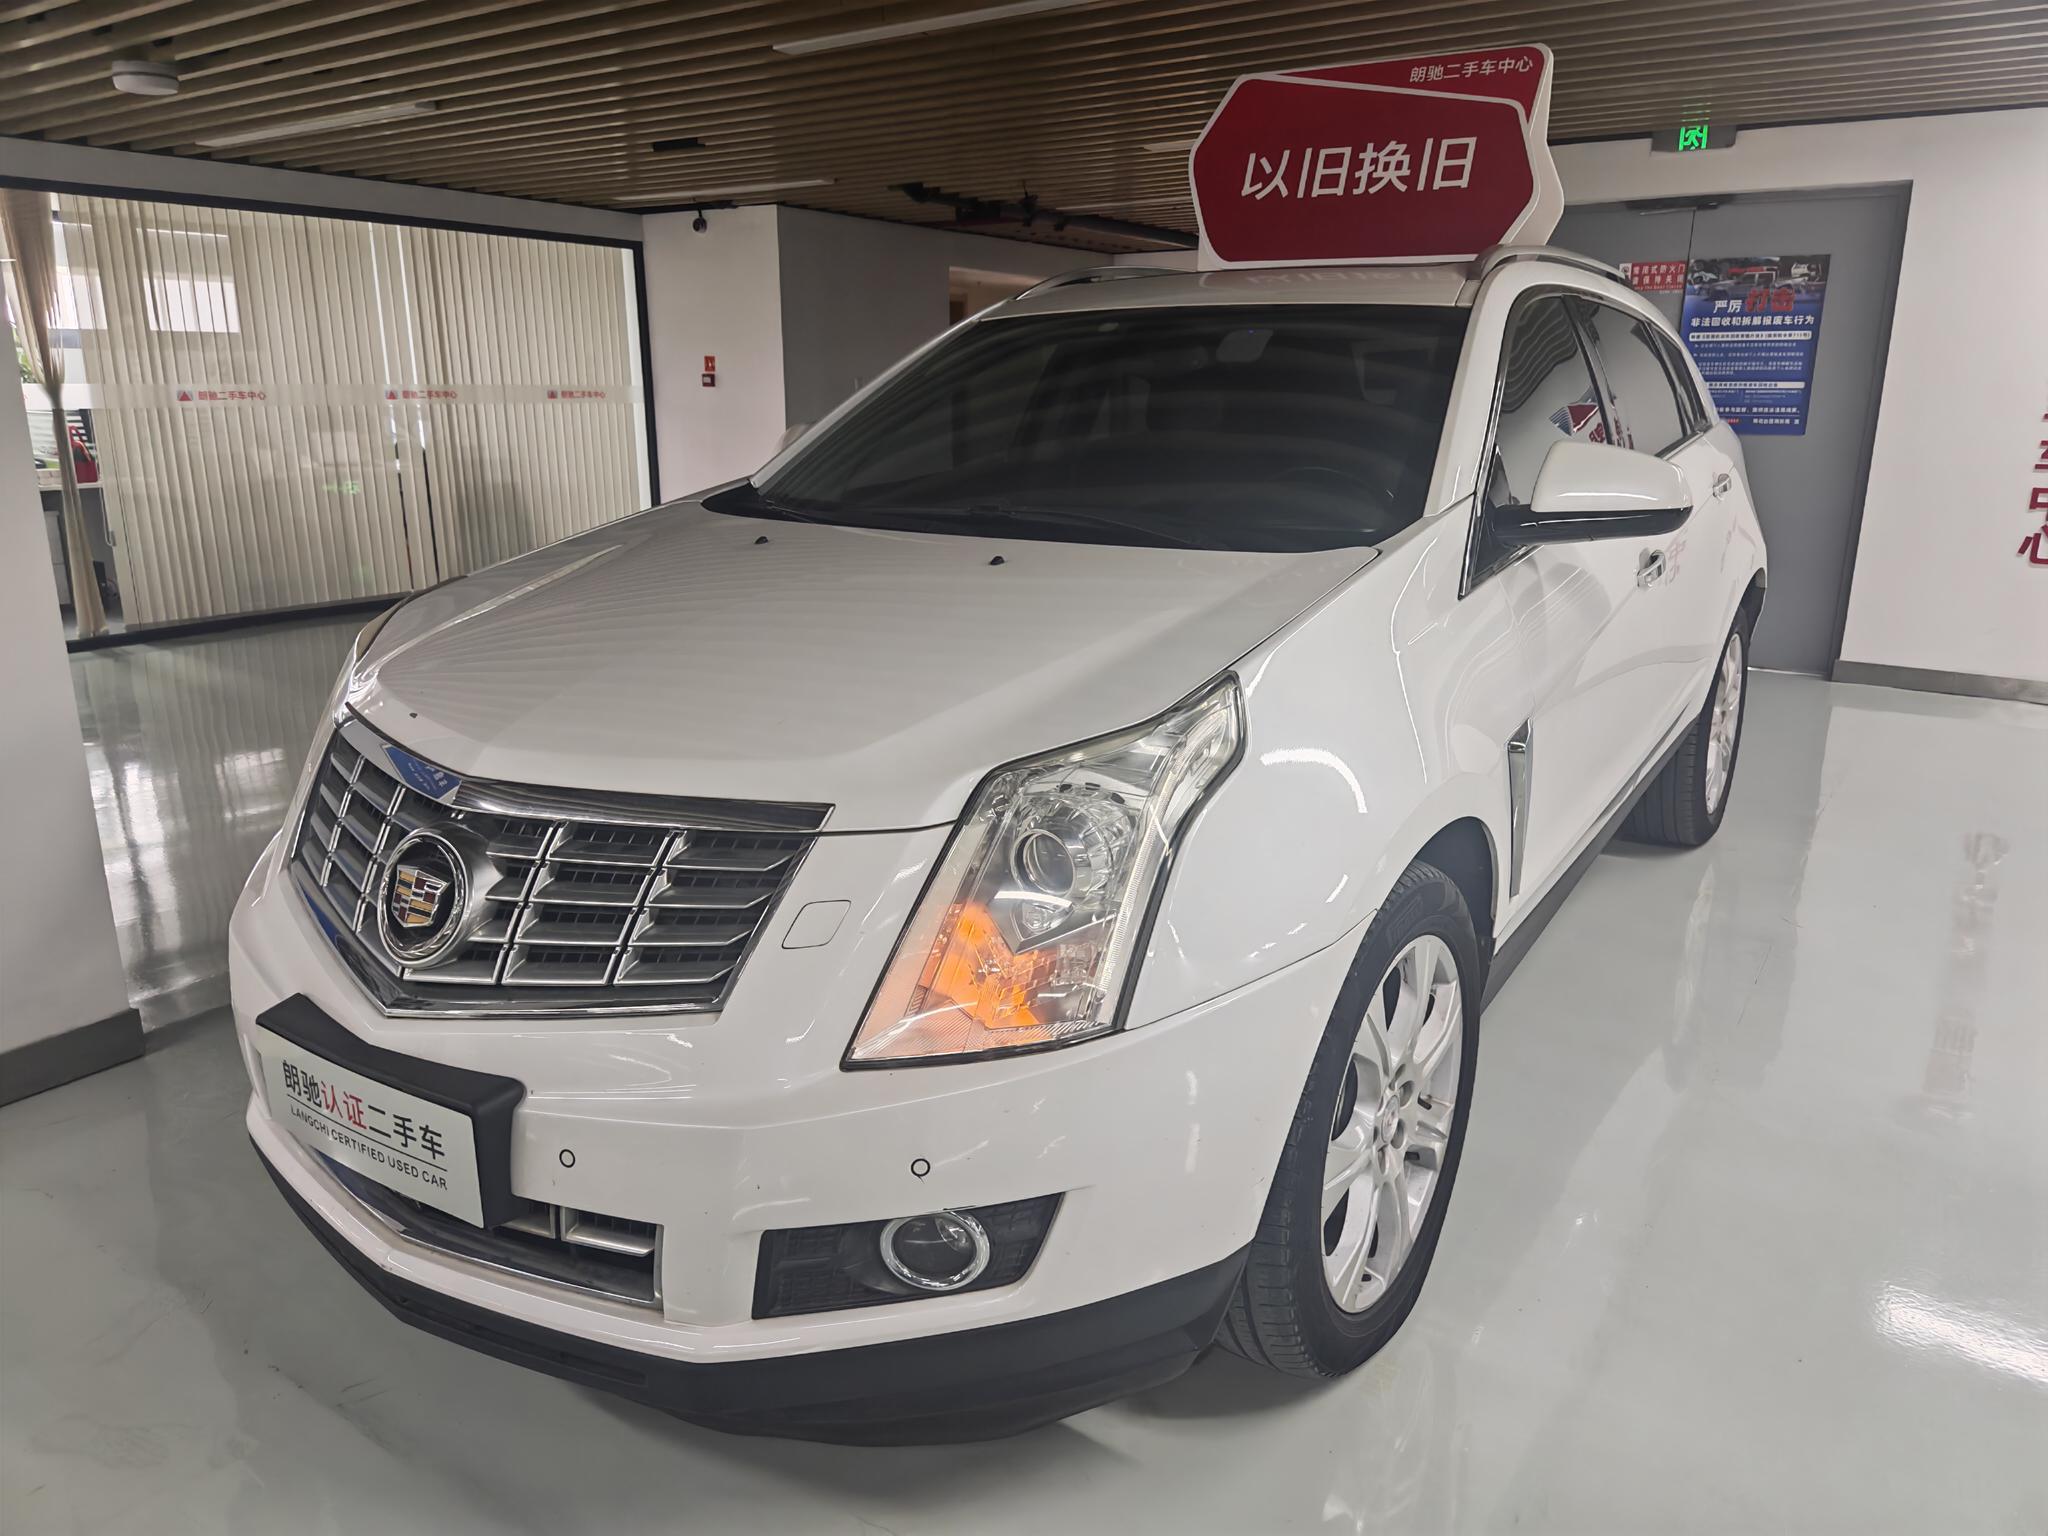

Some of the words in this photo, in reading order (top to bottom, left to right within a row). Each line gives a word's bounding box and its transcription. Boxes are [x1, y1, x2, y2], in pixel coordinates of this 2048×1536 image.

[1409, 56, 1533, 83] 朗驰二手车中心
[1241, 136, 1477, 200] 以旧换旧
[282, 1059, 446, 1160] 朗驰认证二手车
[290, 1104, 330, 1136] LANGCHI
[331, 1129, 385, 1163] CERTIFIED
[387, 1156, 419, 1179] USED
[422, 1170, 448, 1190] CAR
